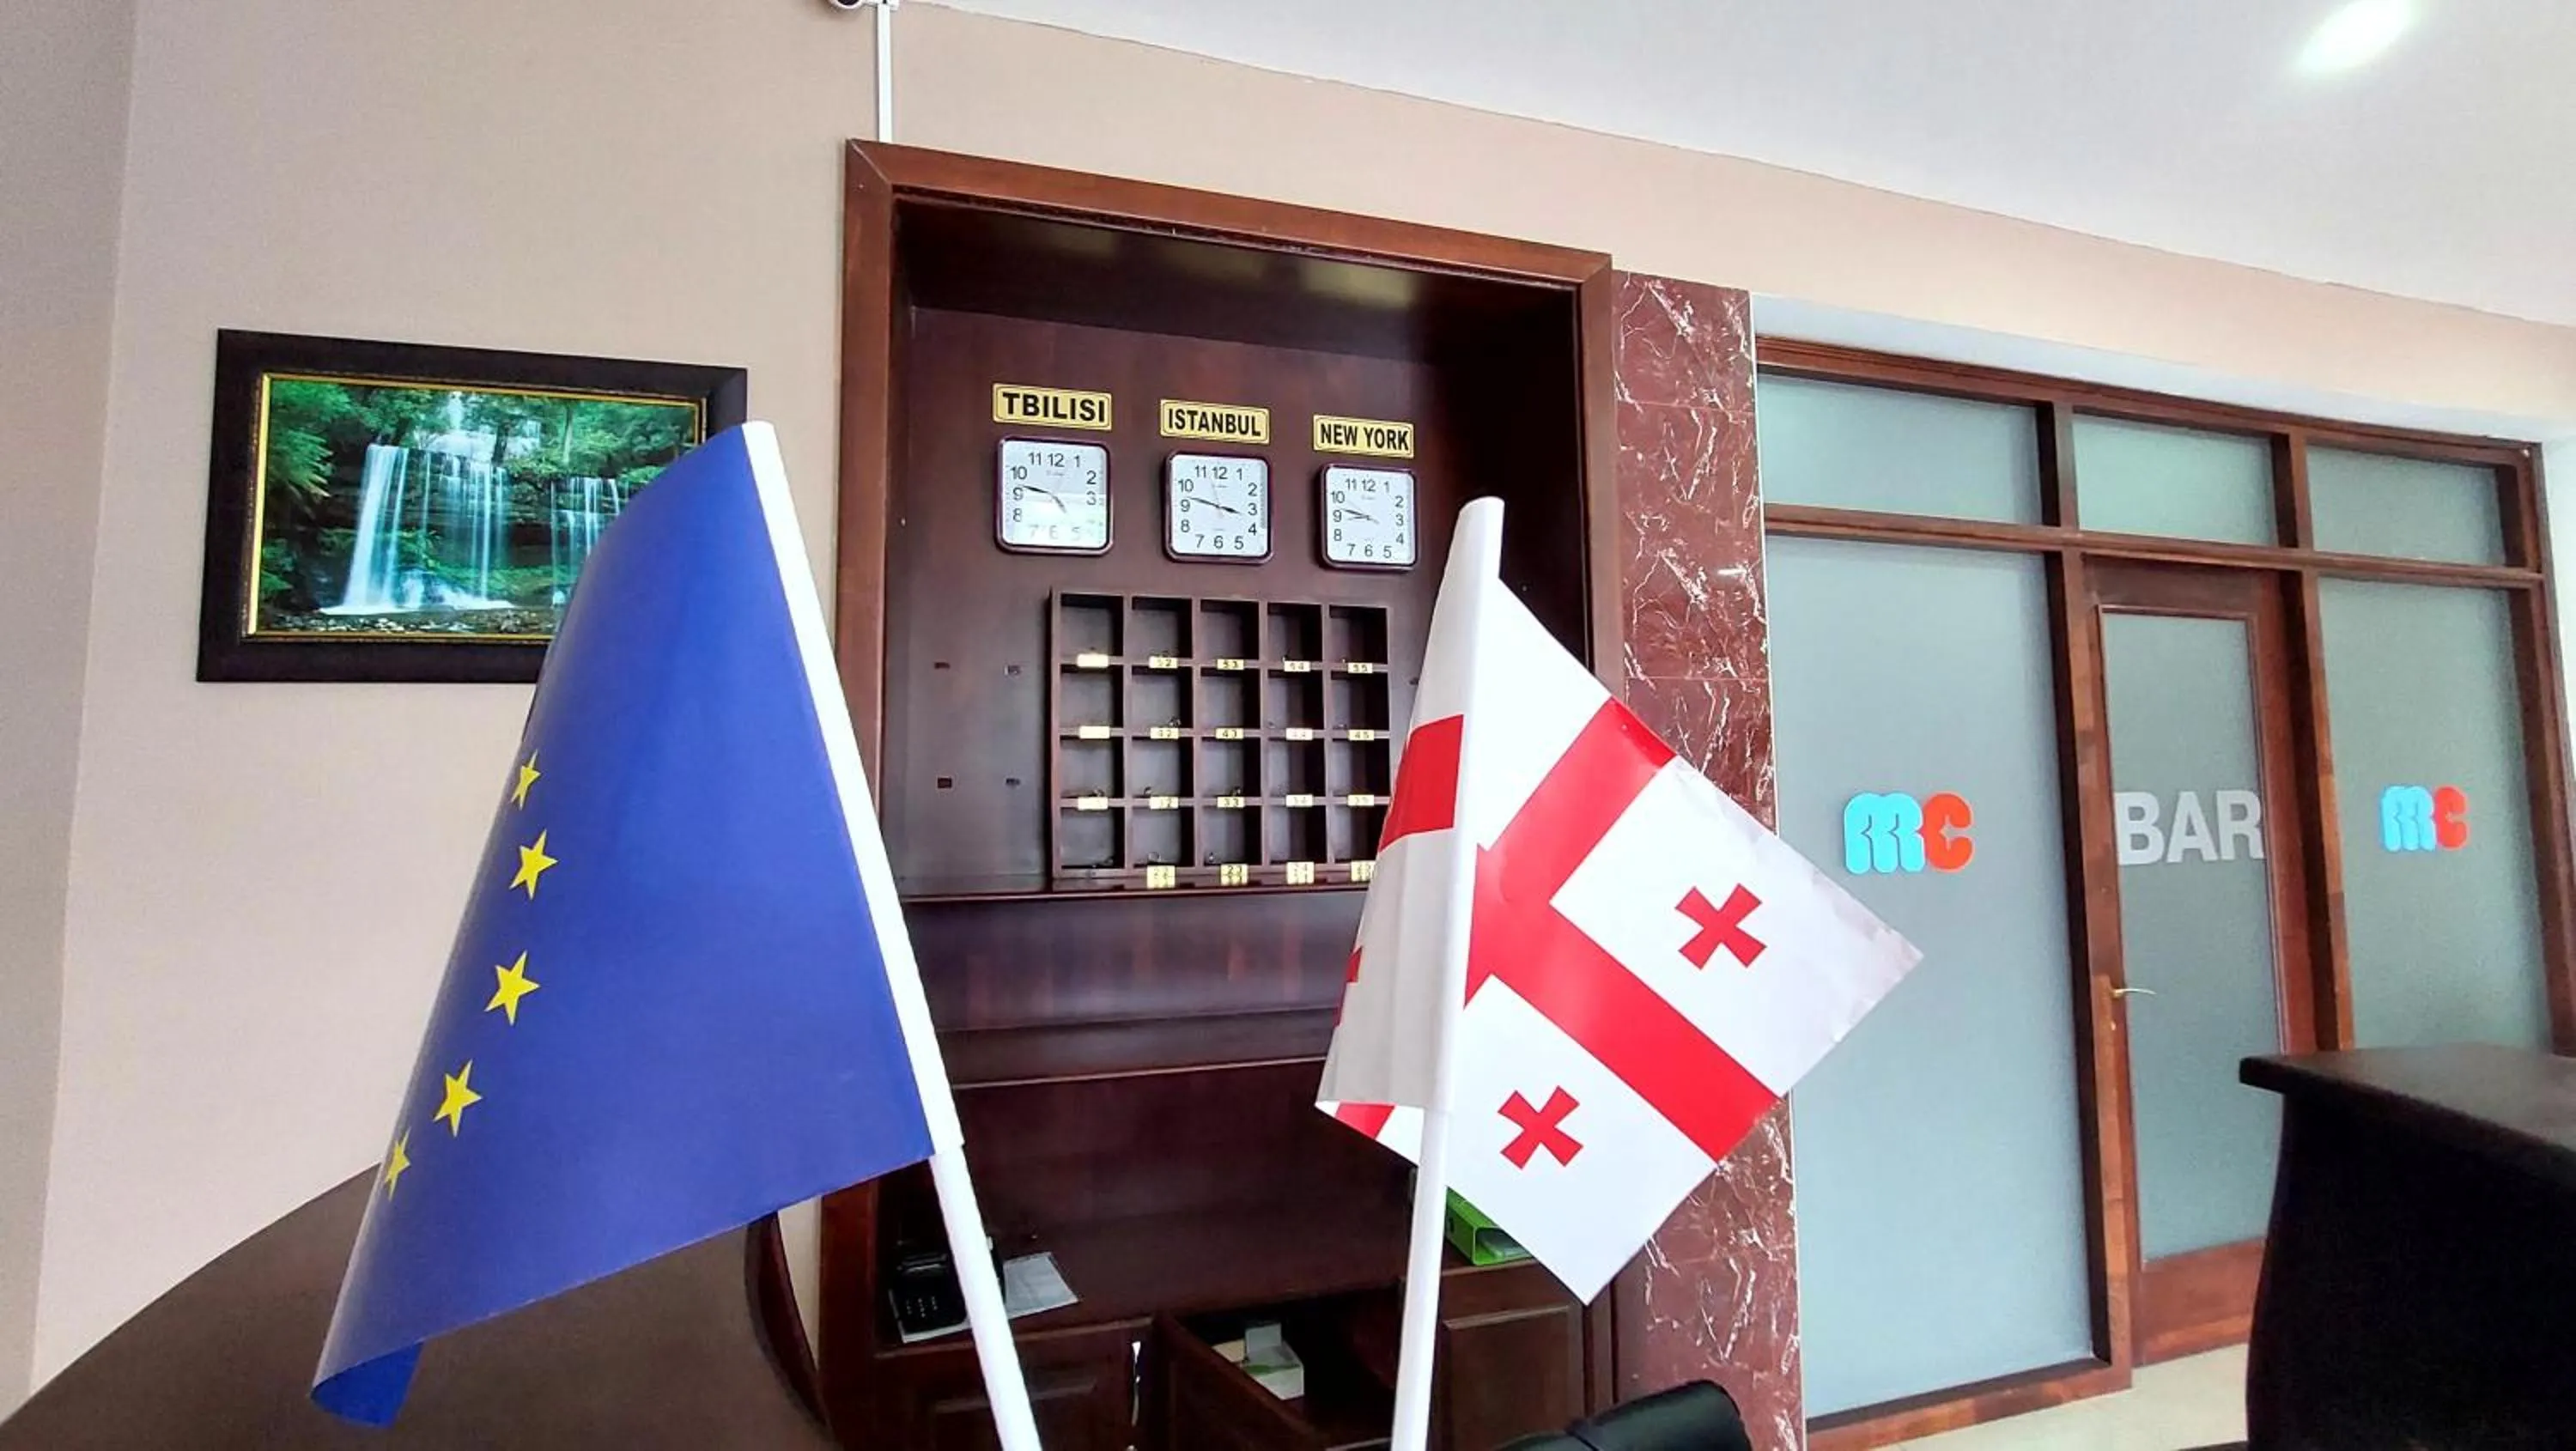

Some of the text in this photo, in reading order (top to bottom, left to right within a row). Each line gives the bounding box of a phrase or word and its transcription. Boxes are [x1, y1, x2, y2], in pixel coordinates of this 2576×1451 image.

[1002, 392, 1105, 422] TBILISI
[1169, 408, 1261, 436] ISTANBUL
[1320, 423, 1409, 451] NEW YORK
[1028, 452, 1042, 465] 11
[1048, 453, 1065, 467] 12
[1074, 455, 1080, 467] 1
[1011, 465, 1028, 480] 10
[1086, 471, 1097, 484] 2
[1195, 465, 1206, 478] 11
[1212, 466, 1228, 479] 12
[1236, 468, 1242, 481] 1
[1178, 478, 1194, 493] 10
[1248, 483, 1258, 496] 2
[1346, 478, 1357, 491] 11
[1362, 479, 1376, 492] 12
[1384, 481, 1389, 493] 1
[1013, 487, 1024, 501] 9
[1086, 491, 1097, 506] 3
[1330, 491, 1345, 504] 10
[1181, 499, 1190, 513] 9
[1394, 495, 1404, 508] 2
[1013, 508, 1022, 522] 8
[1248, 502, 1257, 516] 3
[1333, 509, 1342, 522] 9
[1181, 519, 1190, 532] 8
[1395, 513, 1404, 526] 3
[1248, 522, 1257, 536] 4
[1334, 529, 1342, 542] 8
[1195, 534, 1205, 549] 7
[1213, 535, 1224, 549] 6
[1234, 536, 1244, 549] 5
[1395, 532, 1404, 545] 4
[1347, 543, 1356, 556] 7
[1364, 544, 1373, 557] 6
[1383, 546, 1392, 558] 5
[2114, 790, 2264, 865] BAR
